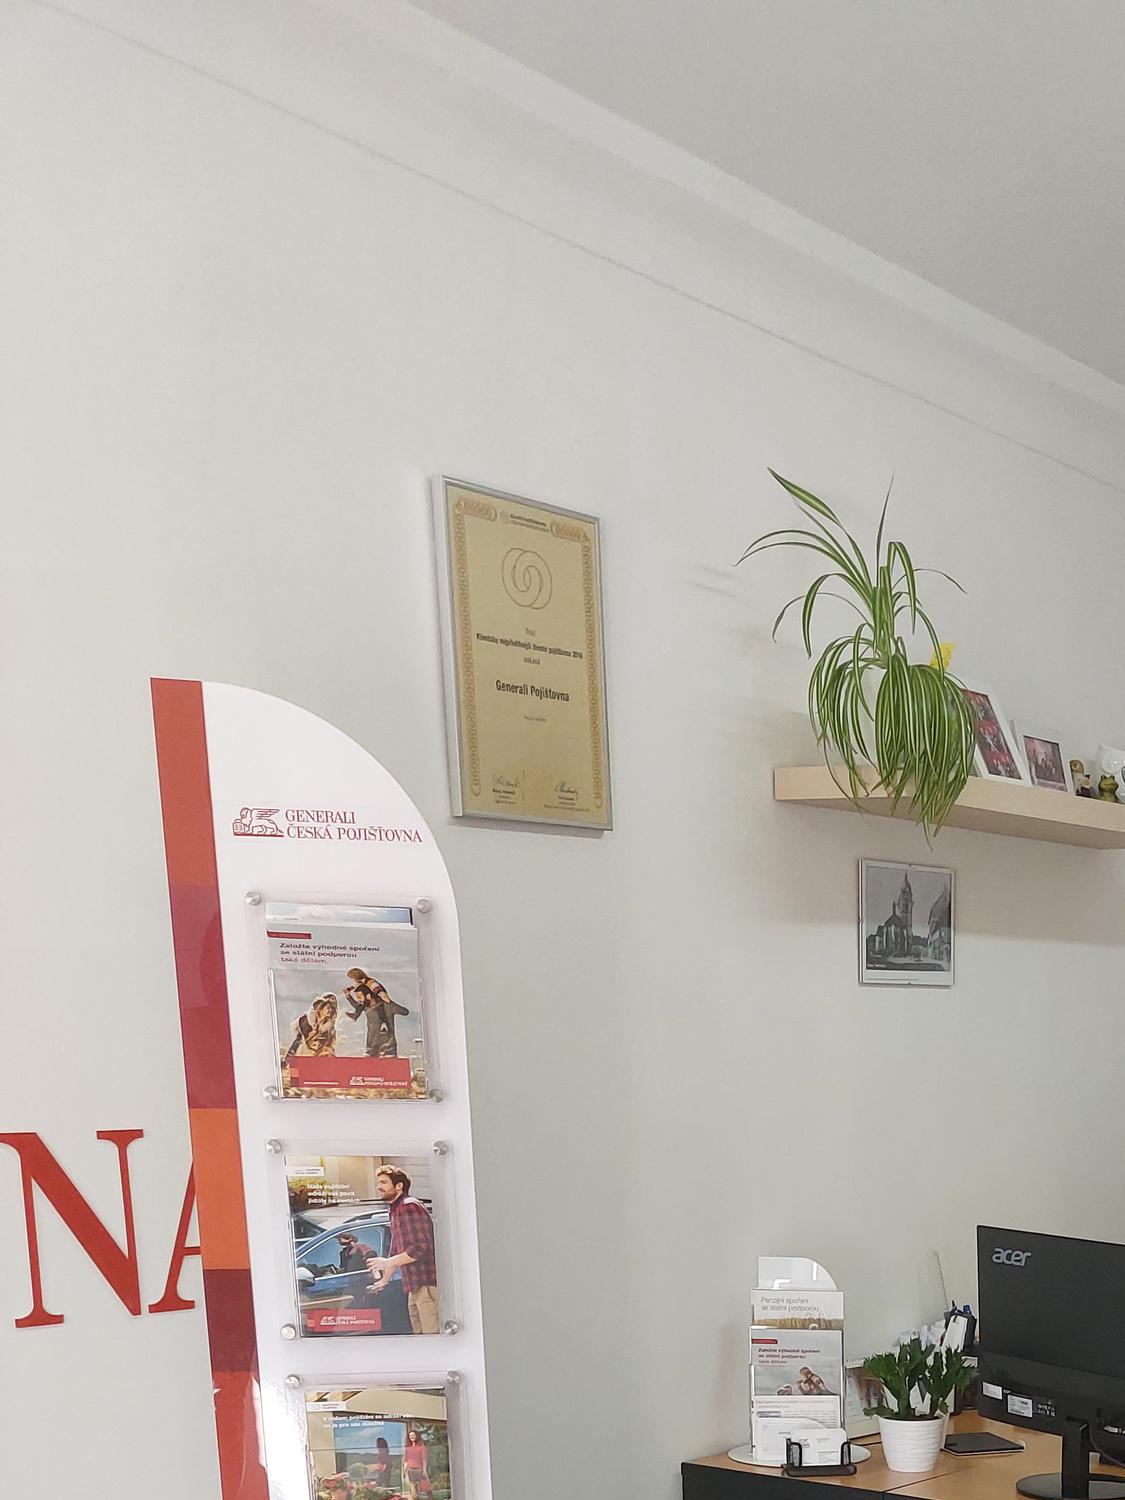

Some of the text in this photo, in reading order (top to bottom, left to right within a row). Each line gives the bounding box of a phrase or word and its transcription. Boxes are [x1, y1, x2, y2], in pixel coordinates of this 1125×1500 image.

[495, 679, 529, 695] Generali
[285, 809, 356, 825] GENERALI
[286, 823, 423, 843] ČESKÁ POJIŠŤOVNA
[992, 1247, 1032, 1267] acer
